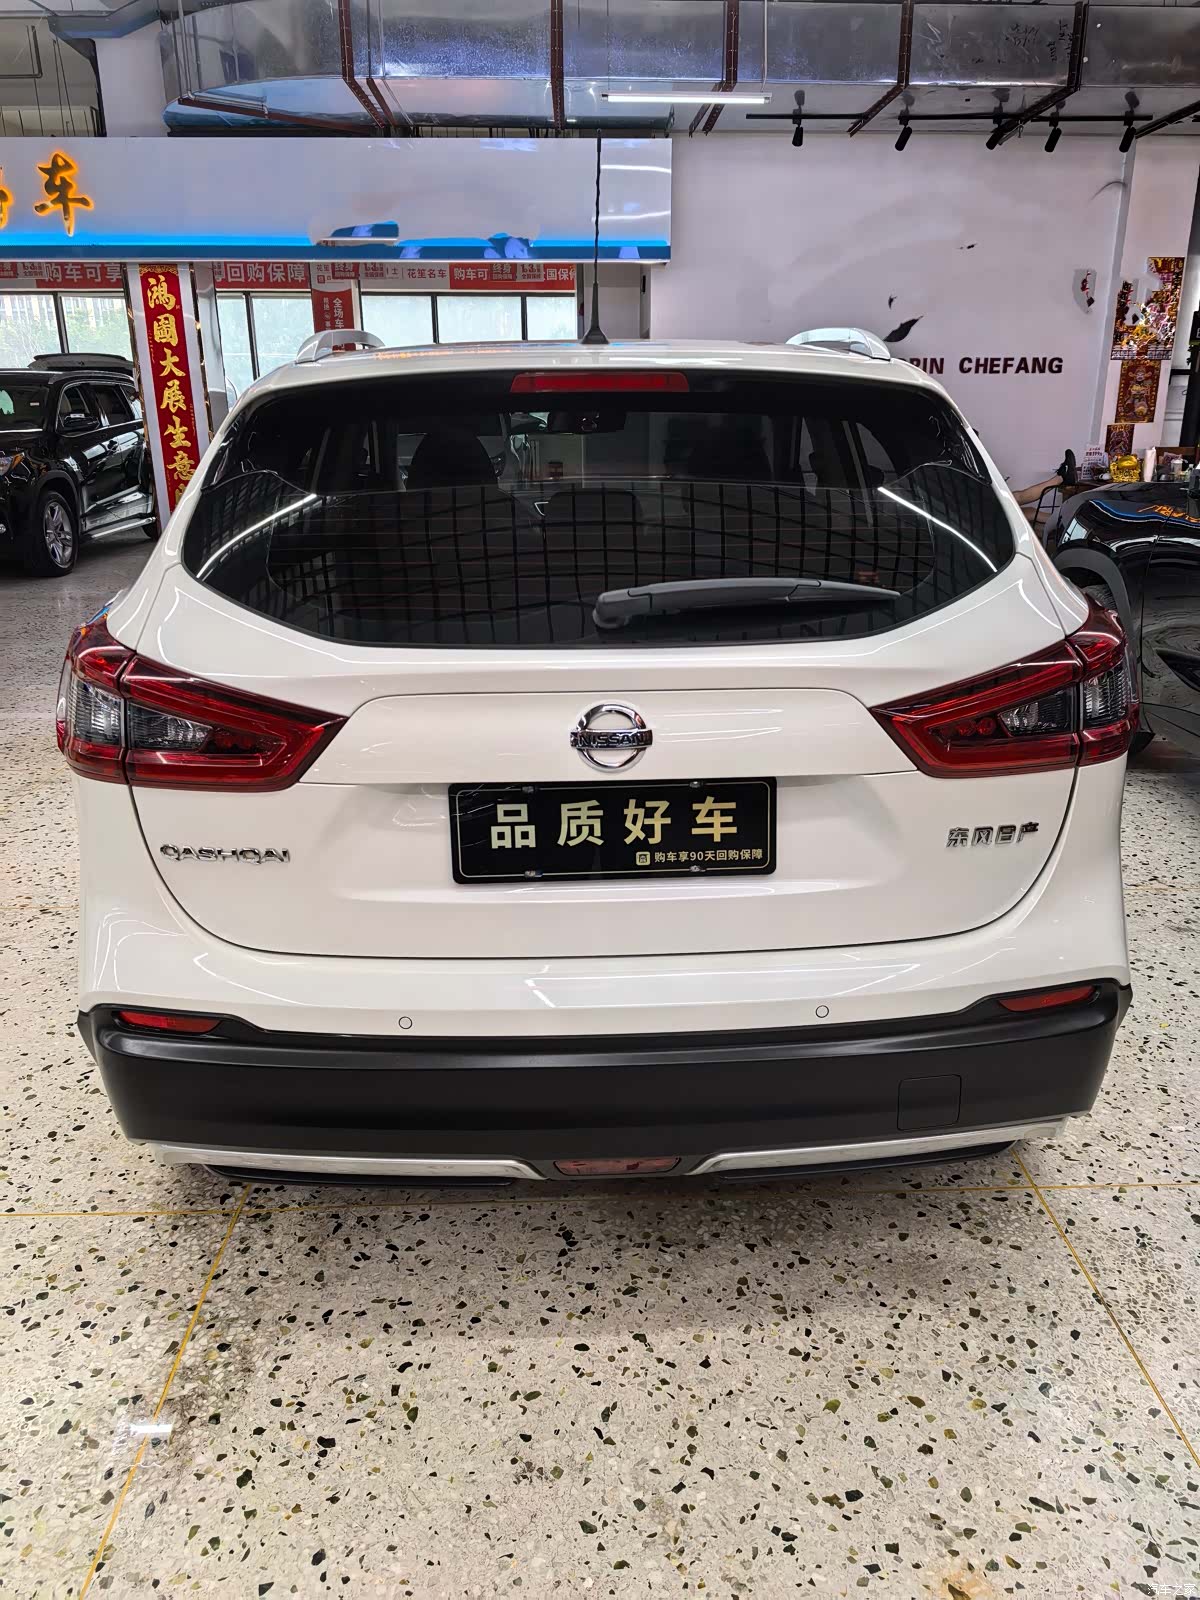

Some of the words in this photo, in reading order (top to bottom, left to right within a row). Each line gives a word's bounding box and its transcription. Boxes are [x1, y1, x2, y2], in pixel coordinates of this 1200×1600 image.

[959, 356, 1064, 374] CHEFANG
[577, 733, 646, 747] NISSAN
[490, 796, 738, 850] 品质好车
[945, 821, 1040, 848] 东风日产
[159, 844, 291, 864] QASHQAI
[654, 848, 763, 863] 购车享90天回购保障
